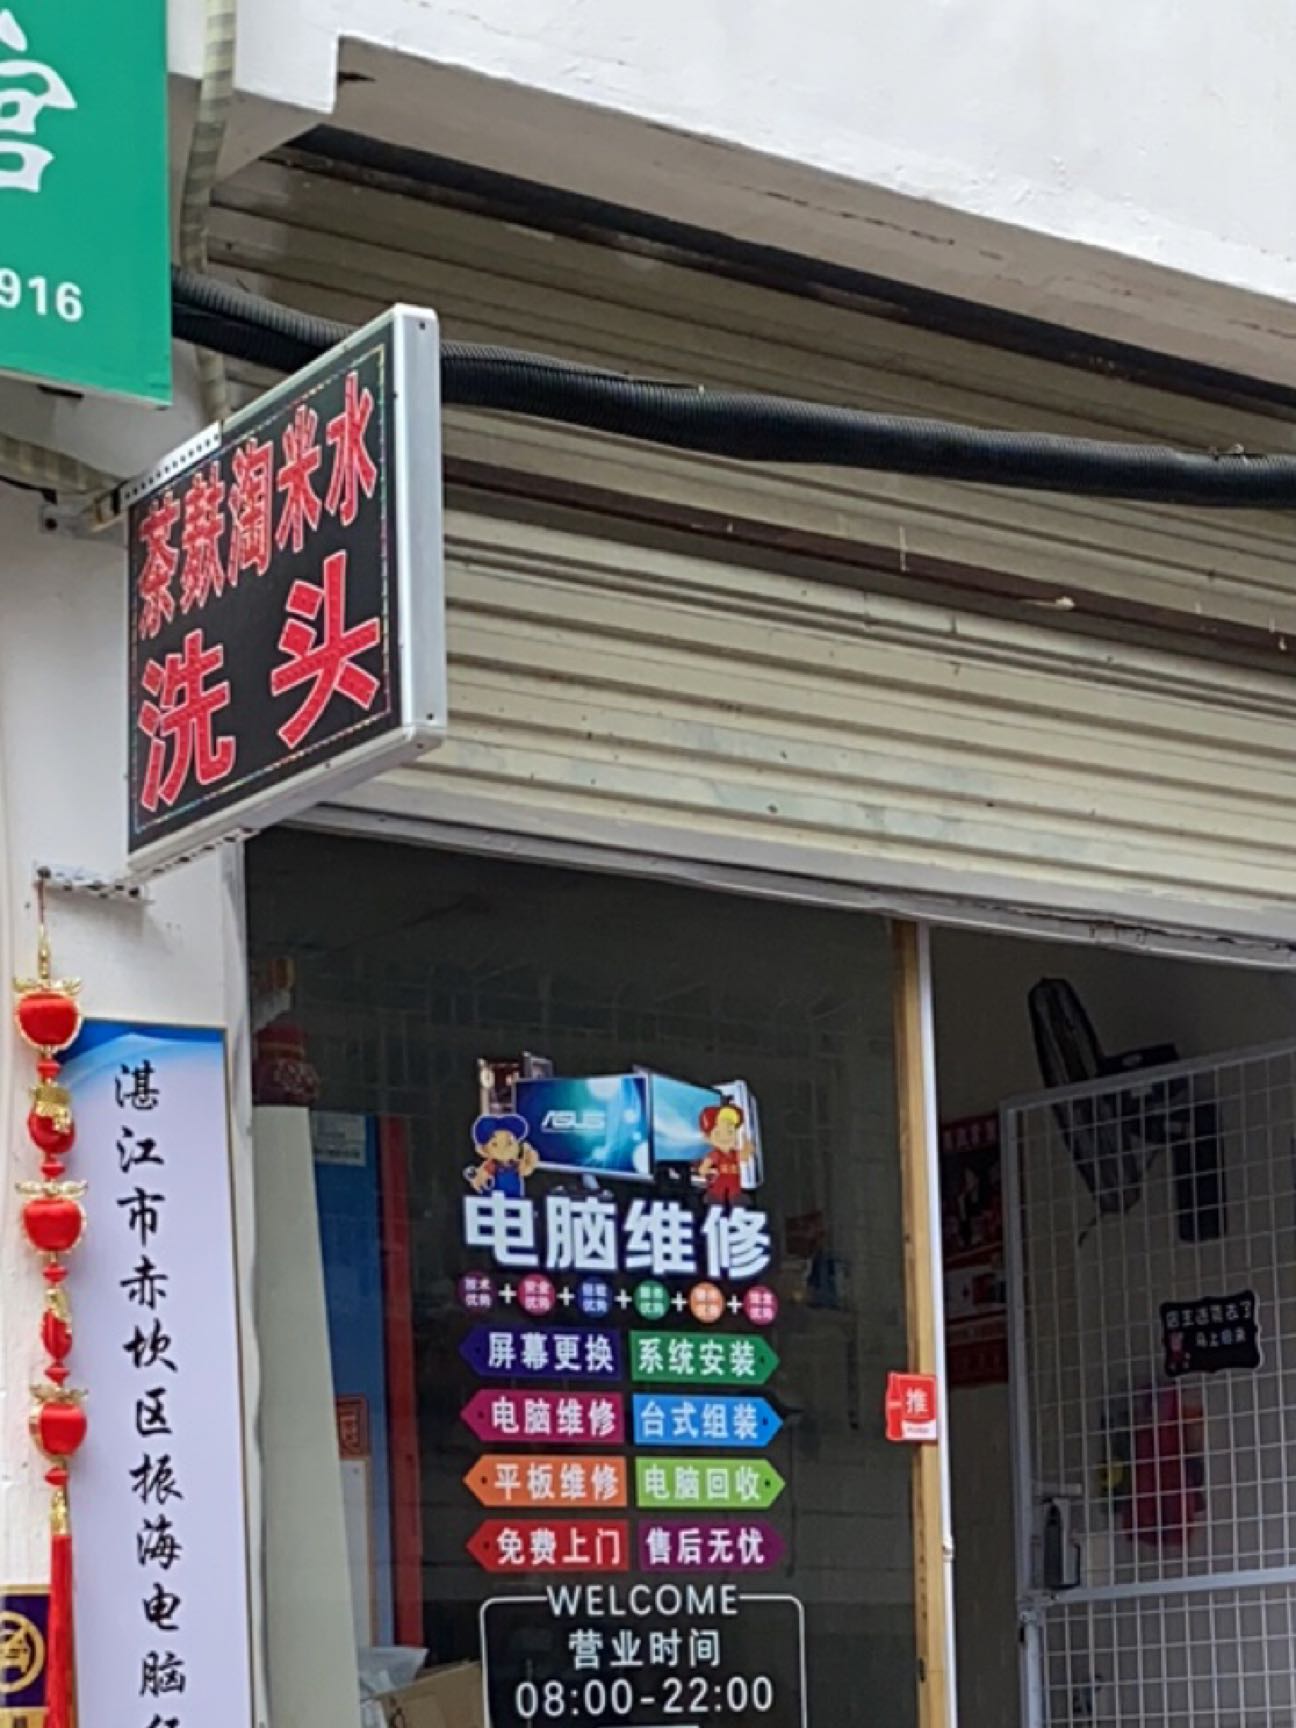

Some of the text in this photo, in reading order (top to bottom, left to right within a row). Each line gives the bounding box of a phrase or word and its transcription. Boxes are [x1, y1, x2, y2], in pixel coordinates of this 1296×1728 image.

[138, 550, 381, 812] 洗头
[541, 1110, 606, 1133] ASUS
[463, 1191, 772, 1280] 电脑维修
[488, 1332, 614, 1373] 屏幕更换
[638, 1337, 756, 1377] 系统安装
[491, 1396, 615, 1436] 电脑维修
[640, 1401, 758, 1440] 台式组装
[495, 1463, 619, 1501] 平板维修
[643, 1464, 762, 1501] 电脑回收
[497, 1528, 621, 1564] 免费上门
[646, 1527, 764, 1564] 售后无忧
[546, 1584, 739, 1617] WELCOME
[568, 1629, 721, 1671] 营业时间
[515, 1676, 774, 1719] 08:00-22:00
